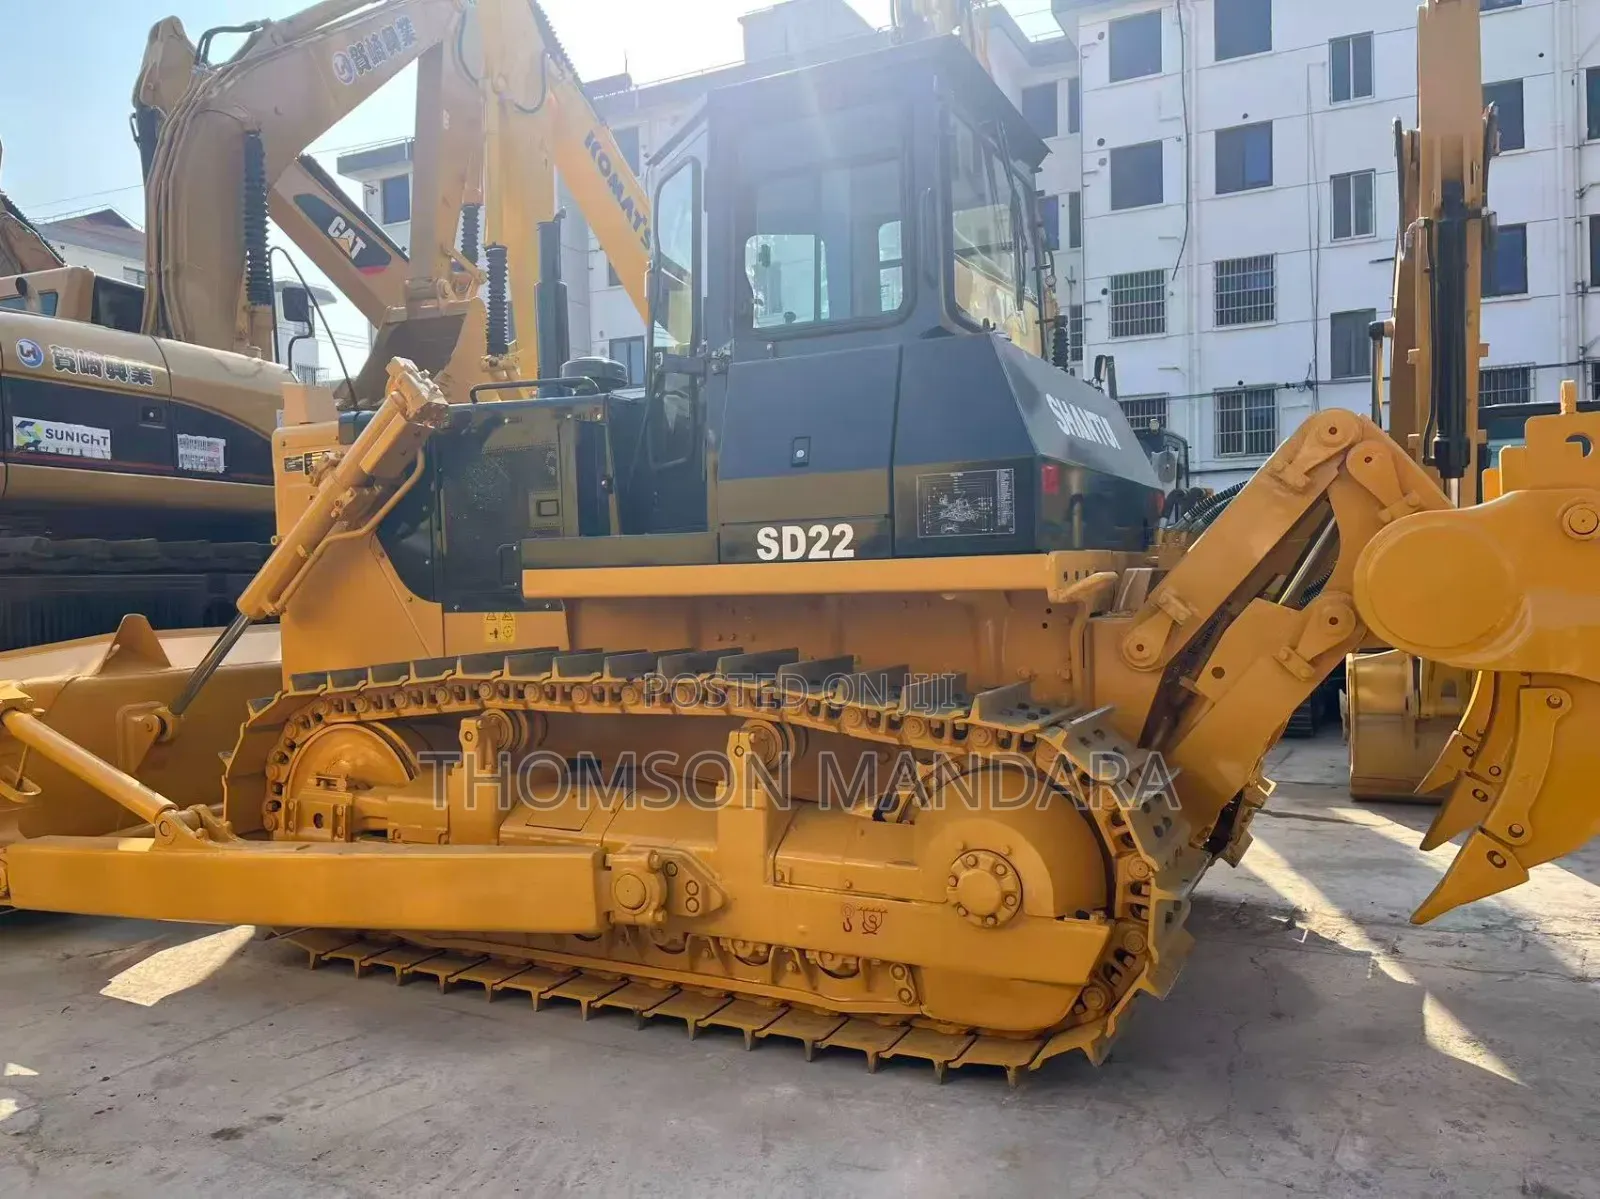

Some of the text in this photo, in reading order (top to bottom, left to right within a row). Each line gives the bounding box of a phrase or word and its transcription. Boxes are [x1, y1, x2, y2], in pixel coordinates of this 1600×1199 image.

[328, 216, 367, 260] CAT
[1046, 393, 1121, 450] SHANTUI
[757, 523, 855, 561] SD22
